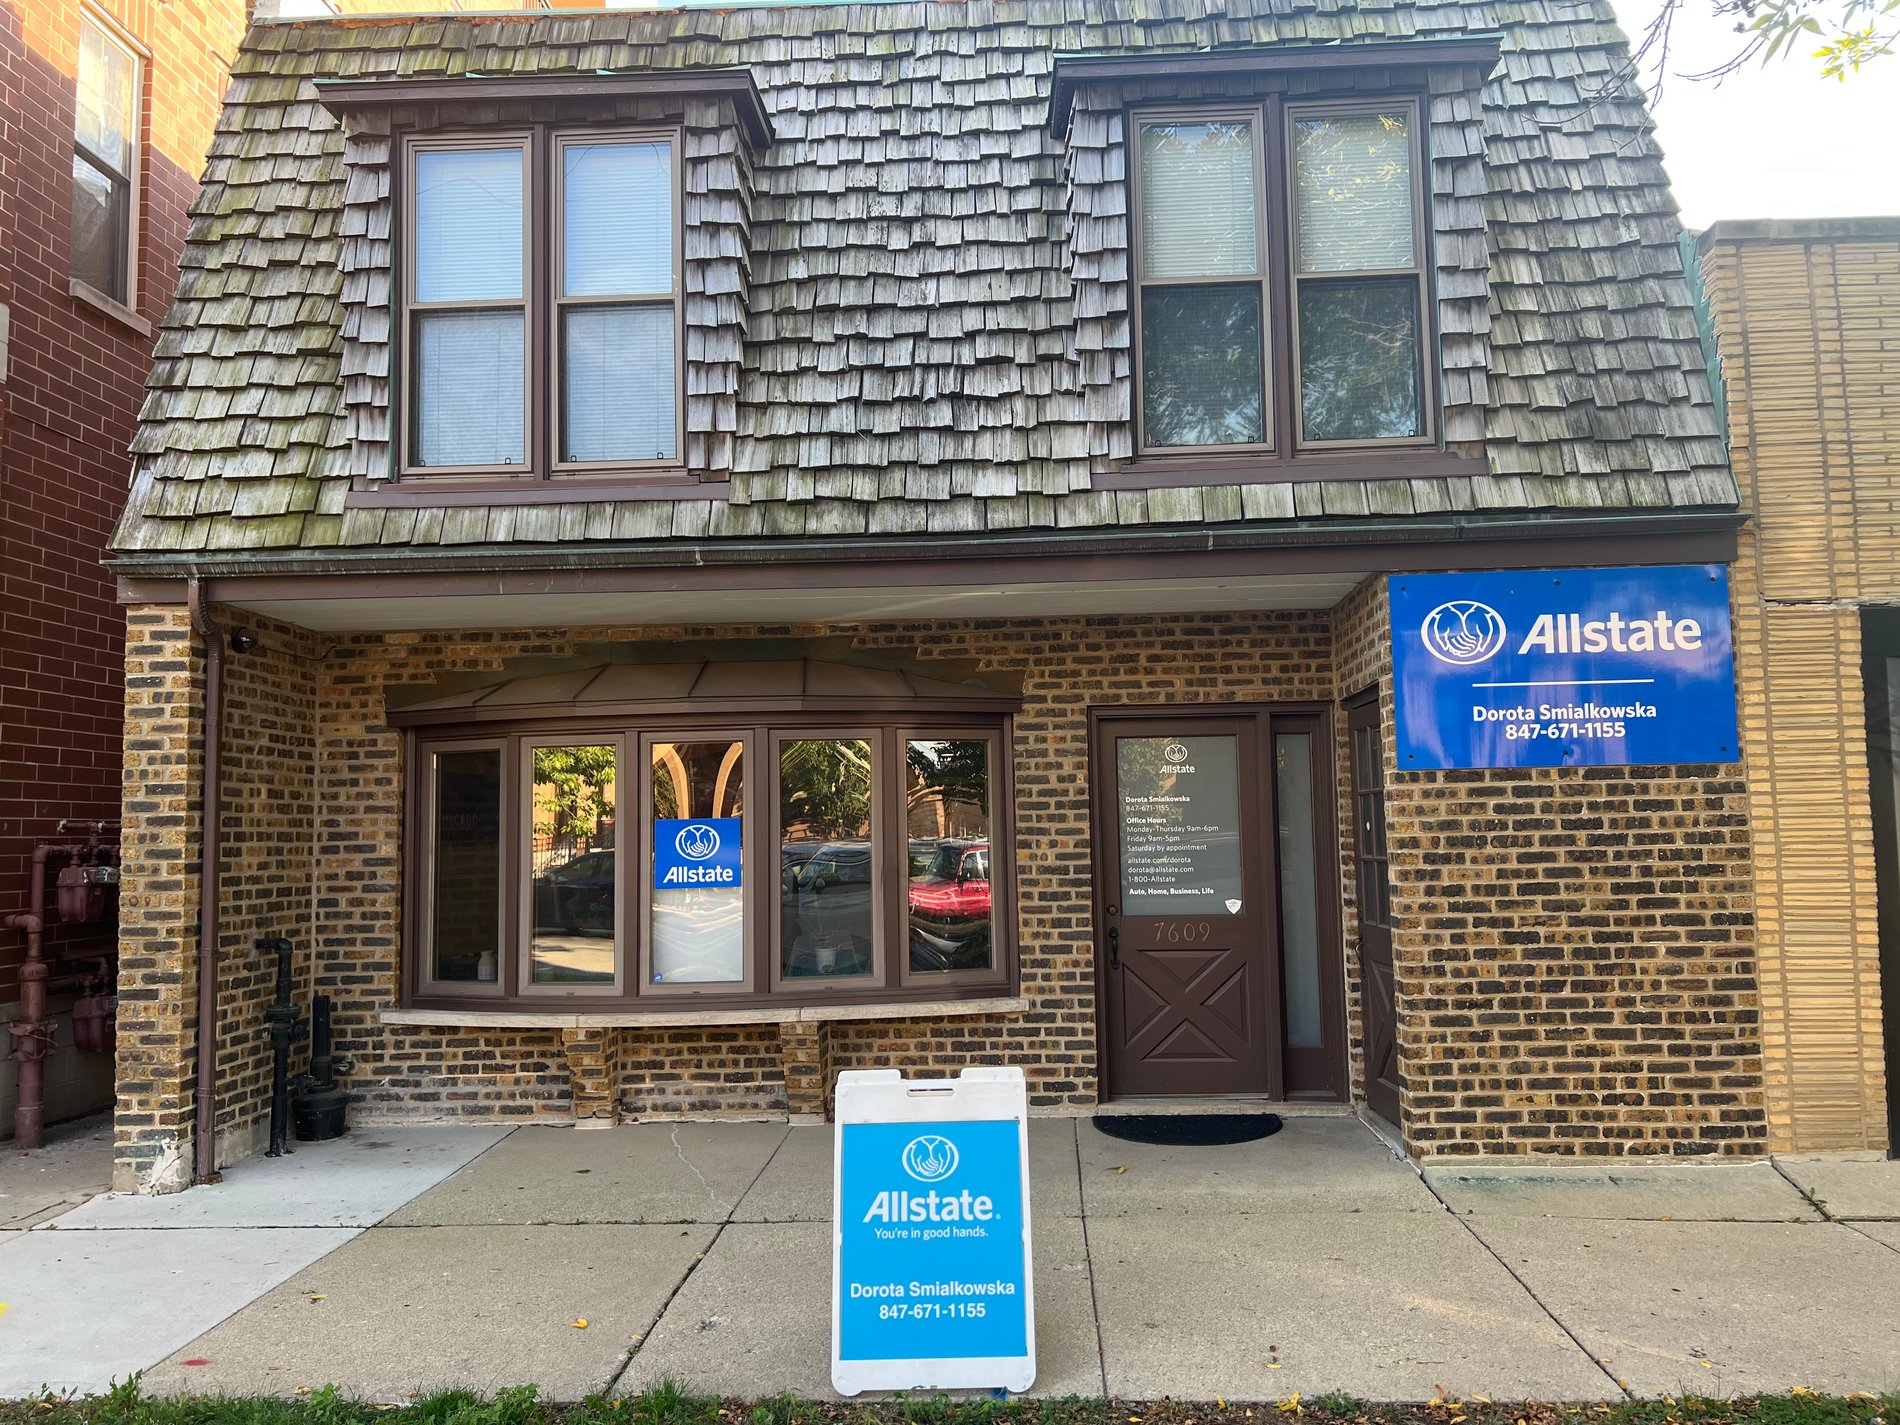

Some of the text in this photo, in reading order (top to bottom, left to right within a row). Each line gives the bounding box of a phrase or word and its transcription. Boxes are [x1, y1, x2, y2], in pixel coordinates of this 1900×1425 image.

[1518, 610, 1702, 654] Allstate
[1472, 702, 1657, 722] Dorota Smialkowska
[1505, 721, 1626, 740] 847-671-1155
[1159, 764, 1196, 774] Allstate
[1149, 795, 1191, 803] Smialkowska
[1126, 804, 1170, 812] 847-671-1155
[1126, 816, 1167, 824] Office Hours
[1126, 824, 1219, 834] Monday-Thursday 9am-6pm
[1127, 835, 1180, 843] Friday 9am-5pm
[1127, 845, 1156, 853] Saturday
[1166, 844, 1208, 852] appointment
[1128, 856, 1192, 864] allstate.com/dorota
[662, 865, 734, 884] Allstate
[1128, 866, 1194, 874] dorota@allstate.com
[1129, 888, 1147, 896] Auto,
[1148, 888, 1169, 896] Home,
[1154, 922, 1210, 943] 7609
[862, 1189, 993, 1223] Allstate
[874, 1226, 989, 1240] You're in good hands.
[850, 1280, 1015, 1298] Dorota Smialkowska
[879, 1302, 986, 1319] 847-671-1155
